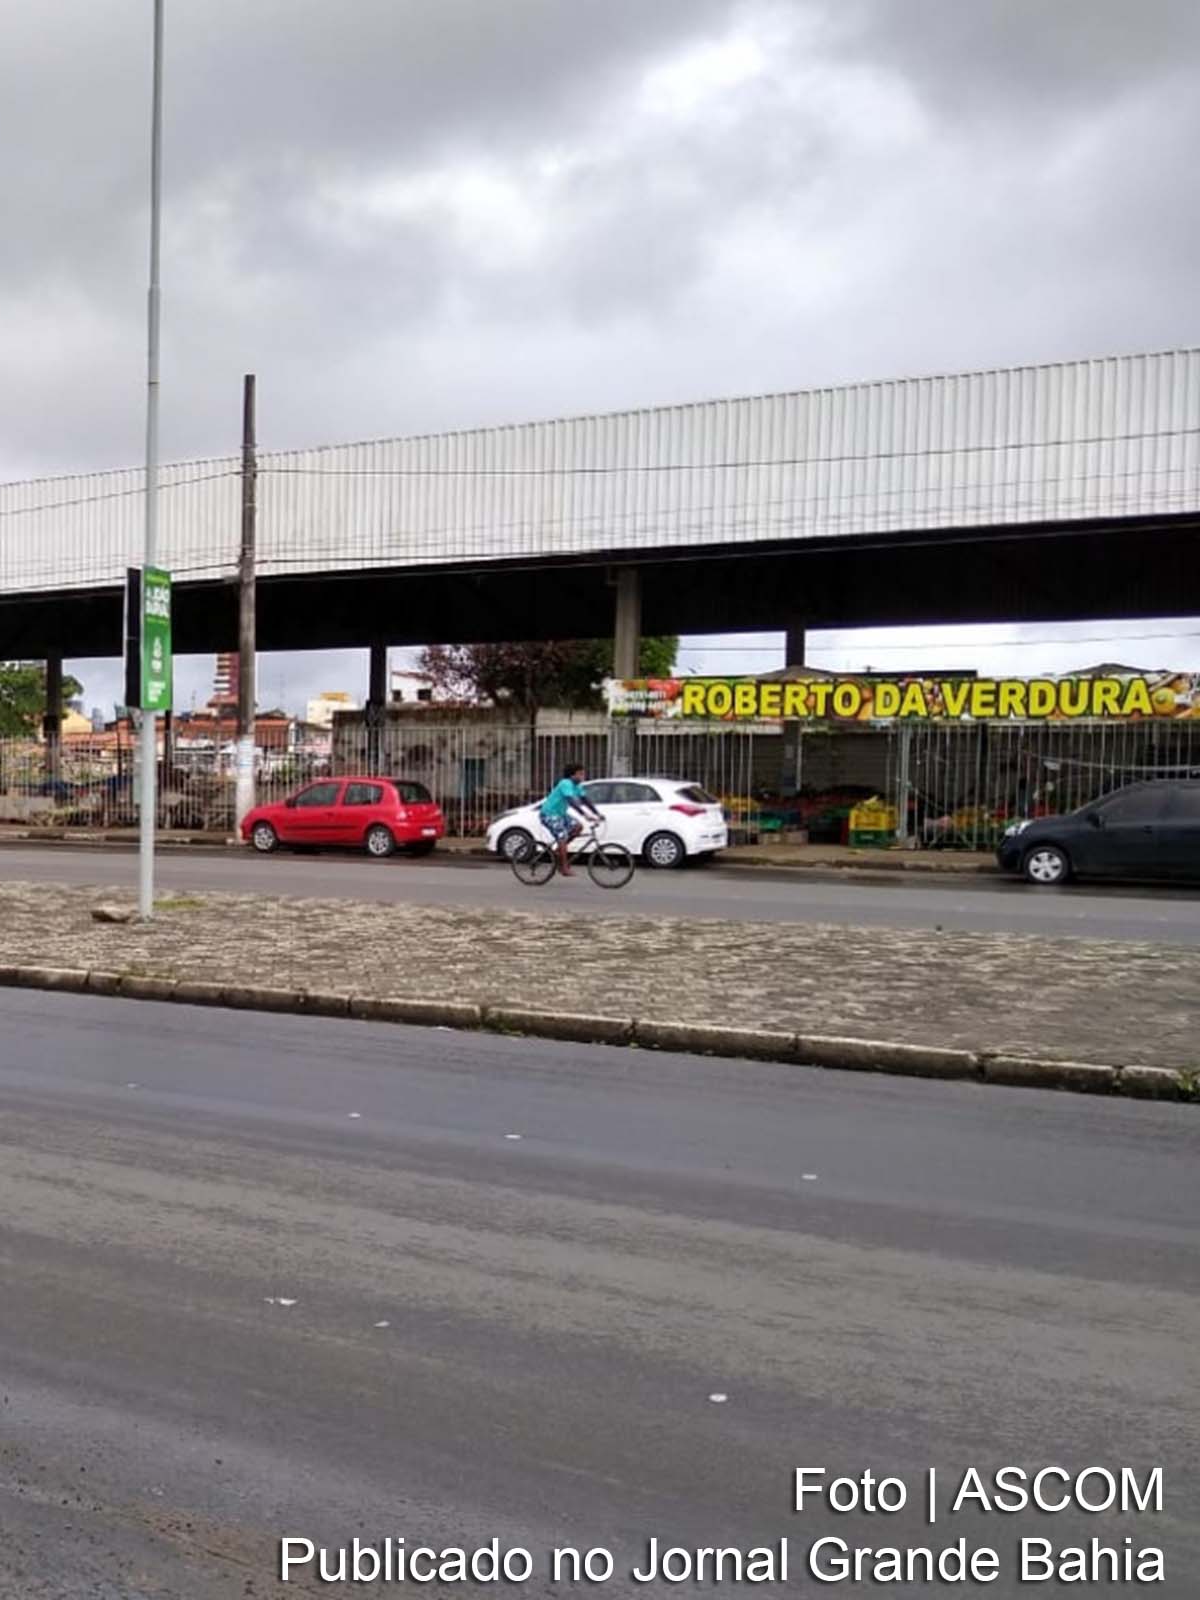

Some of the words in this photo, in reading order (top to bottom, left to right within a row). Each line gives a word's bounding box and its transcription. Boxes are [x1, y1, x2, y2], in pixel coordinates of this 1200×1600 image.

[682, 681, 861, 718] ROBERTO
[875, 682, 929, 717] DA
[941, 678, 1154, 717] VERDURA
